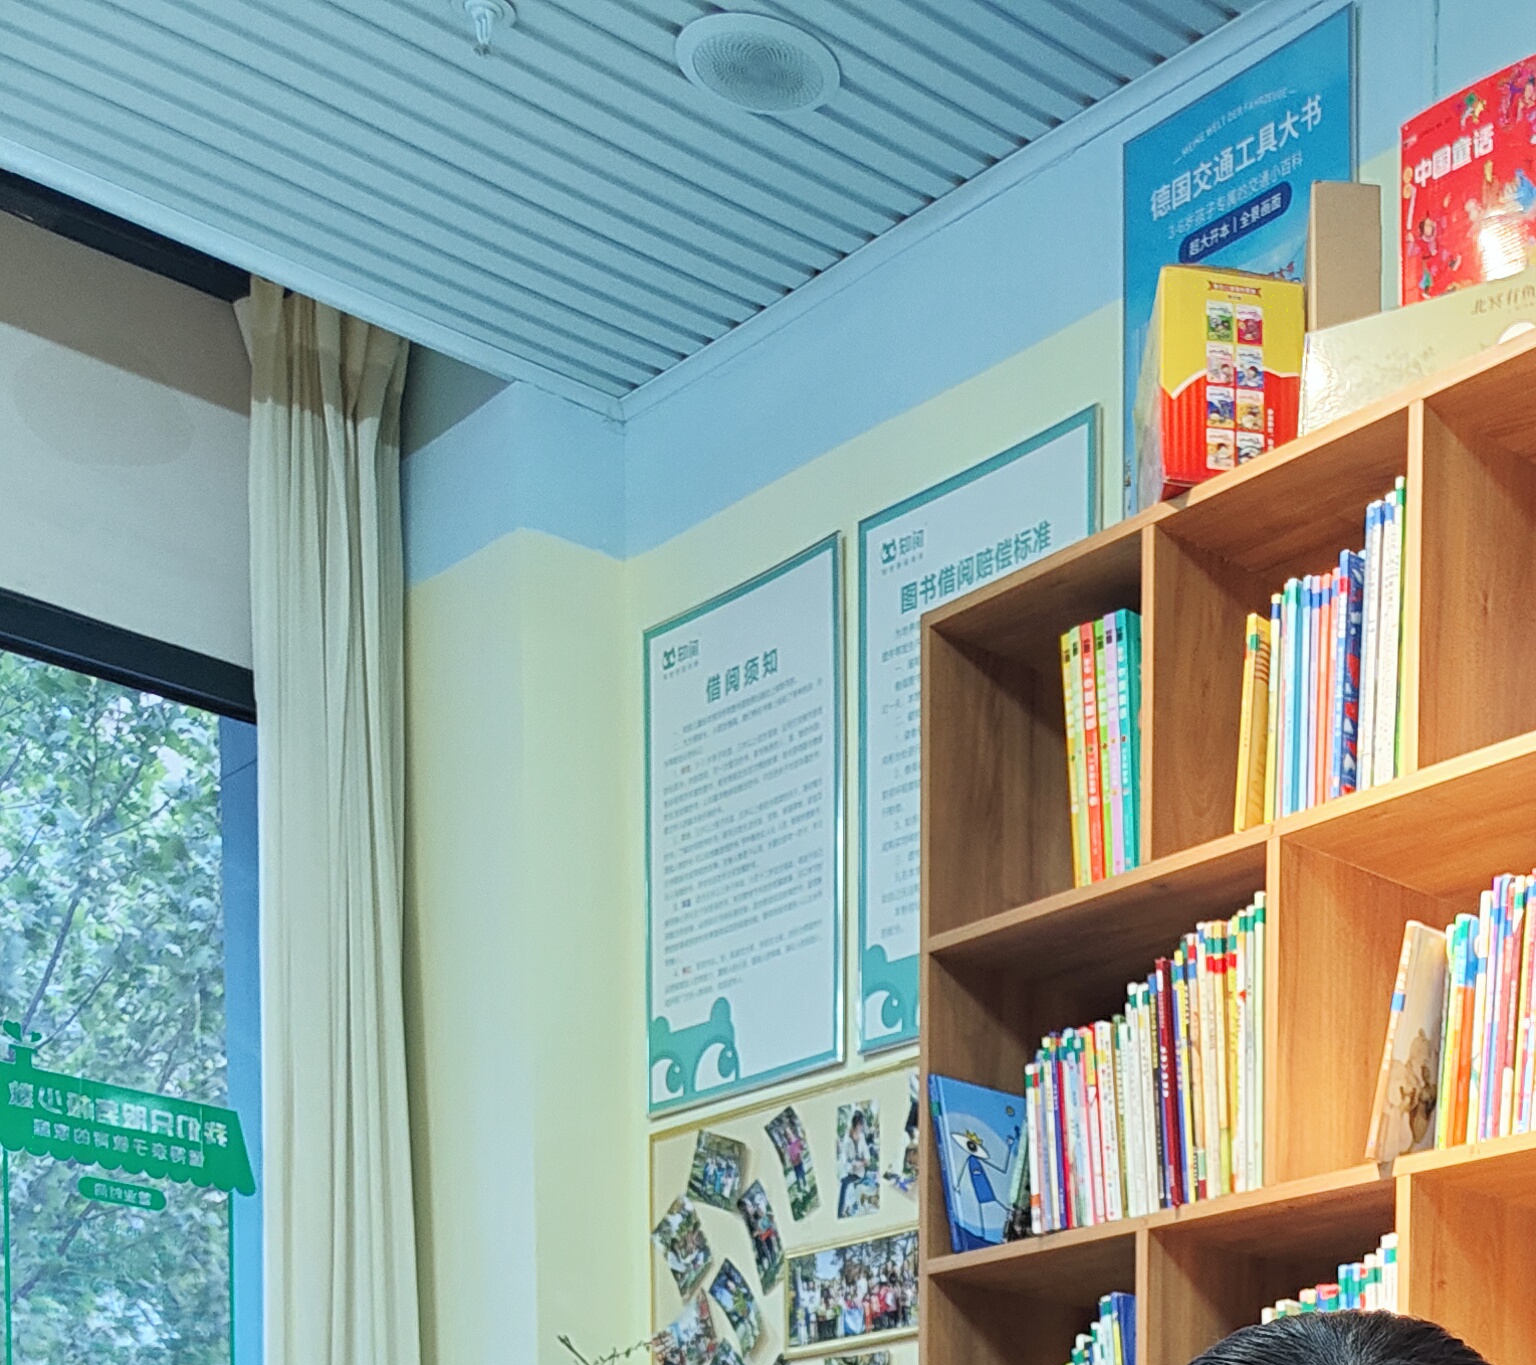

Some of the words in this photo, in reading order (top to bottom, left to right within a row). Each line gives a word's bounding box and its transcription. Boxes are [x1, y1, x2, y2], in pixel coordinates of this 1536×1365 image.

[1151, 94, 1322, 222] 德国交通工具大书
[1414, 123, 1494, 188] 中国童话
[1188, 222, 1231, 258] 超大开本
[1238, 192, 1283, 230] 全景画面
[900, 521, 1052, 615] 图书借阅赔偿标准
[706, 648, 779, 704] 借阅须知
